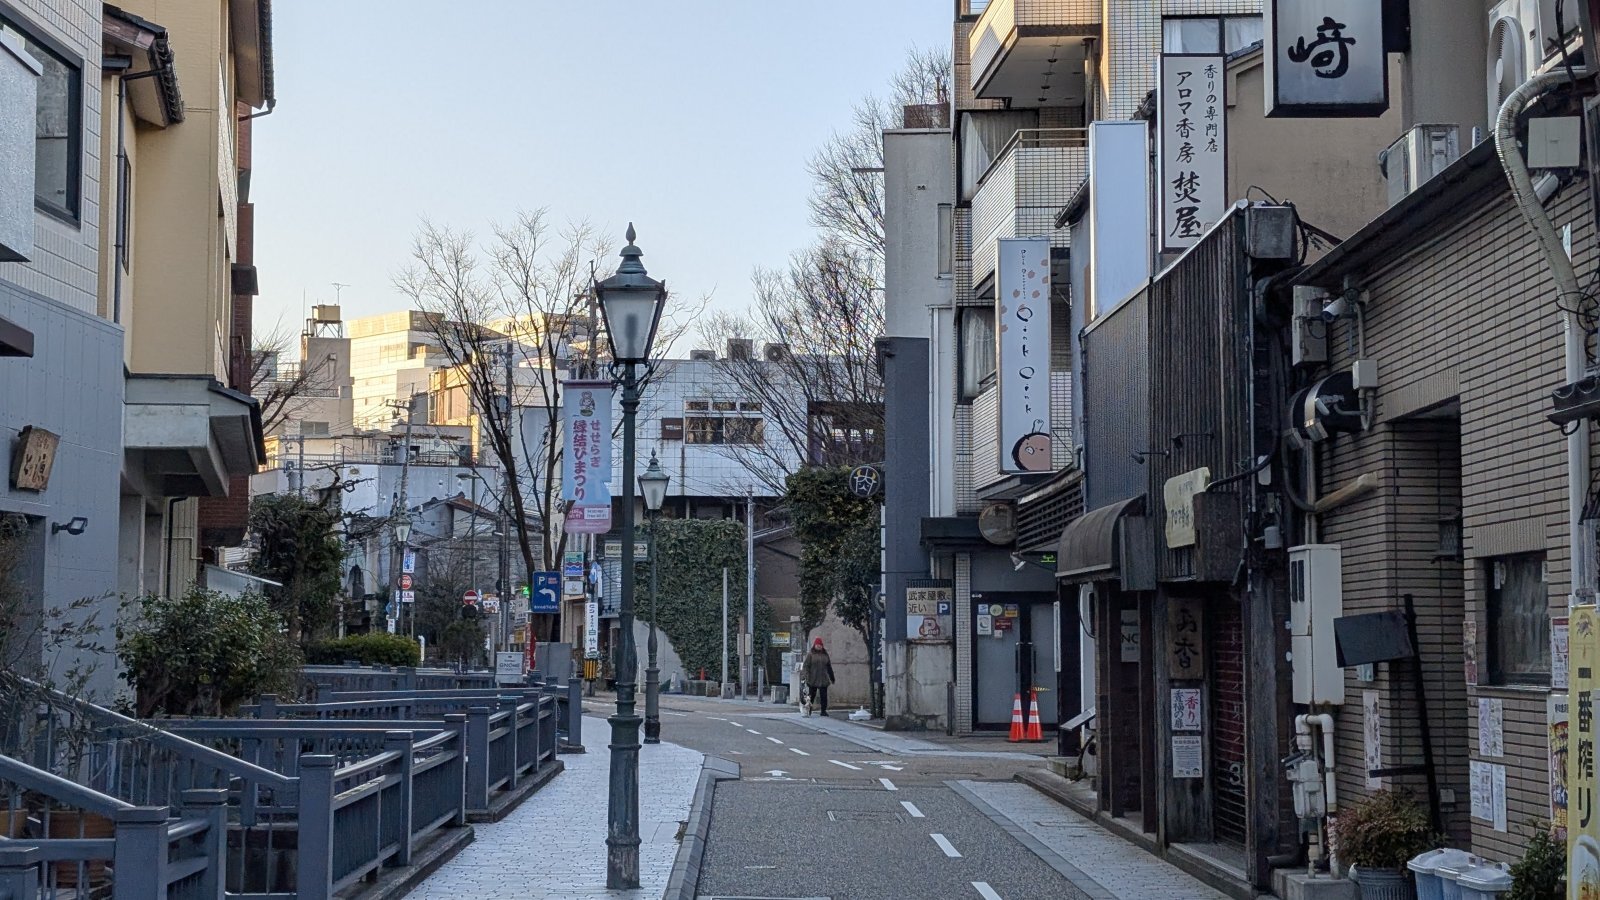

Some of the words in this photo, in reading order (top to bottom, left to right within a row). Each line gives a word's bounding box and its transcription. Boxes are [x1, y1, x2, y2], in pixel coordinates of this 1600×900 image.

[1175, 71, 1195, 163] アロマ香房
[1204, 64, 1218, 152] 香りの専門店
[1170, 170, 1202, 238] 焚屋
[1016, 307, 1033, 357] Oink
[1019, 366, 1035, 413] Oink
[573, 420, 587, 501] 縁結びまつり
[590, 420, 601, 468] せせらぎ
[538, 576, 546, 585] P
[908, 603, 927, 613] 近い
[938, 603, 948, 613] P
[1185, 696, 1198, 724] 香り
[1577, 667, 1594, 829] 一番搾り
